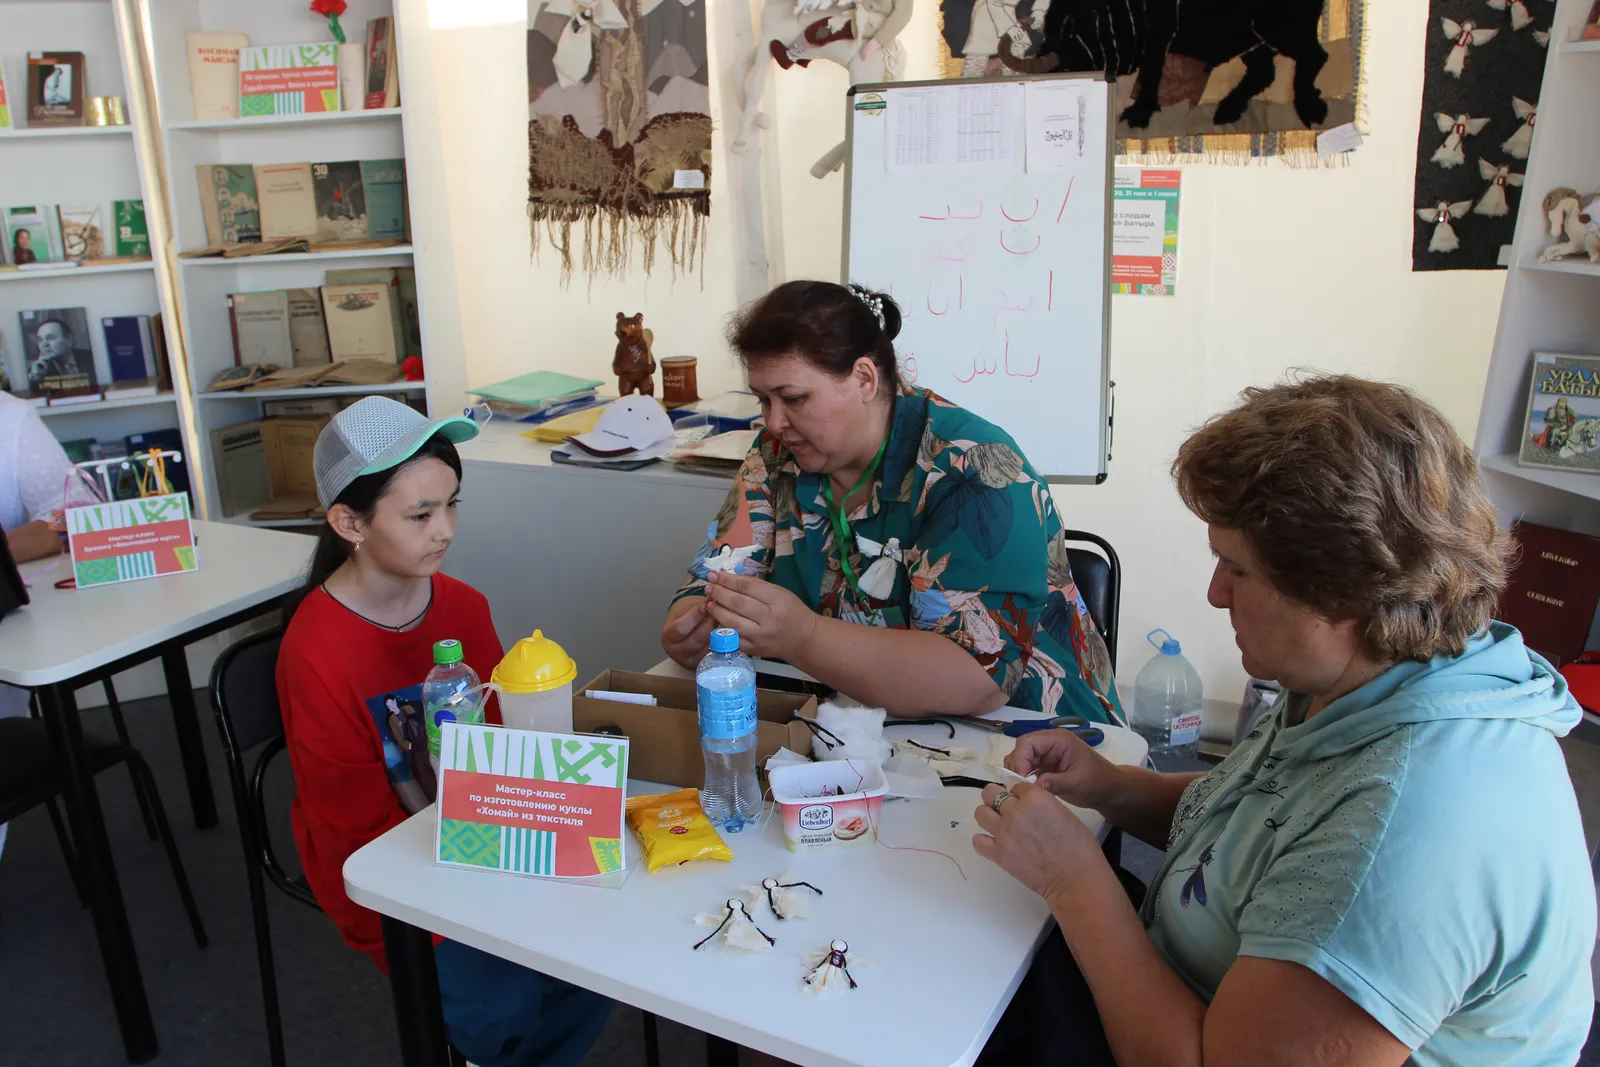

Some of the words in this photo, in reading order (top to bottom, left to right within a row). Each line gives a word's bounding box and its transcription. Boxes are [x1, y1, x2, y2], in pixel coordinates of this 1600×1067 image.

[1114, 219, 1155, 228] ал-Батыра
[1541, 380, 1600, 397] БАТЫ
[108, 531, 156, 542] Мастер-класс
[495, 783, 567, 800] Мастер-класс
[469, 794, 482, 802] по
[484, 794, 557, 811] изготовлению
[559, 804, 593, 816] куклы
[476, 806, 519, 819] «Хомай»
[522, 812, 534, 821] из
[536, 814, 584, 827] текстиля
